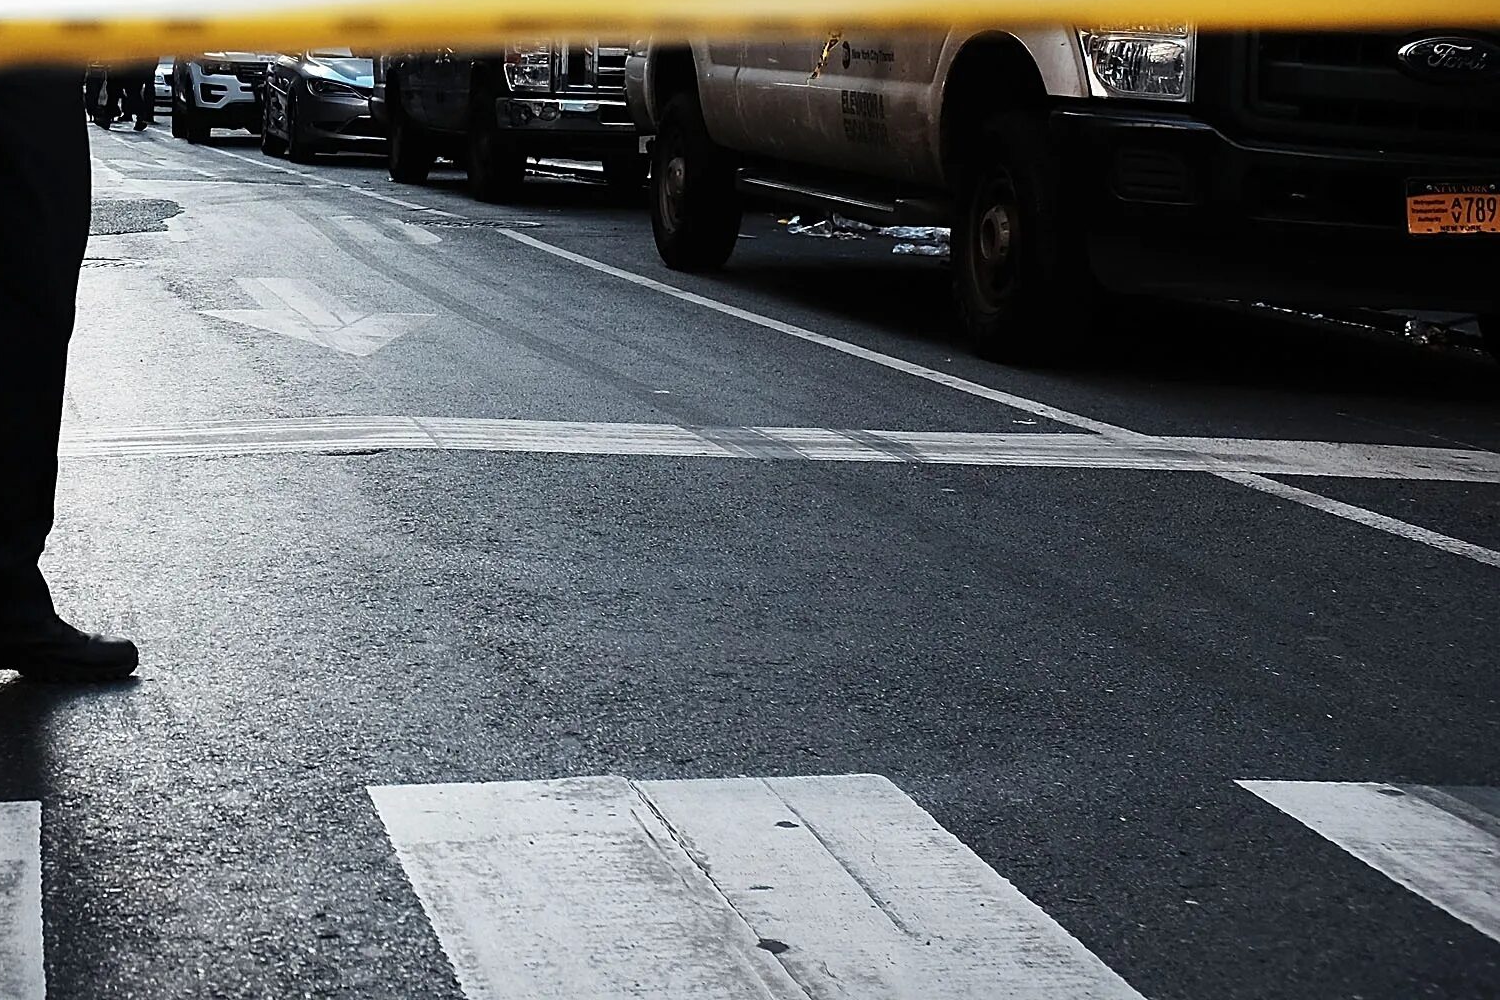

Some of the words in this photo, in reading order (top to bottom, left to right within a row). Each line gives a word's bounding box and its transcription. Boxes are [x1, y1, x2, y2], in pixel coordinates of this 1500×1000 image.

[1427, 43, 1488, 70] Ford
[1432, 184, 1460, 193] NEW
[1461, 184, 1488, 193] YORK
[1464, 197, 1497, 223] 789
